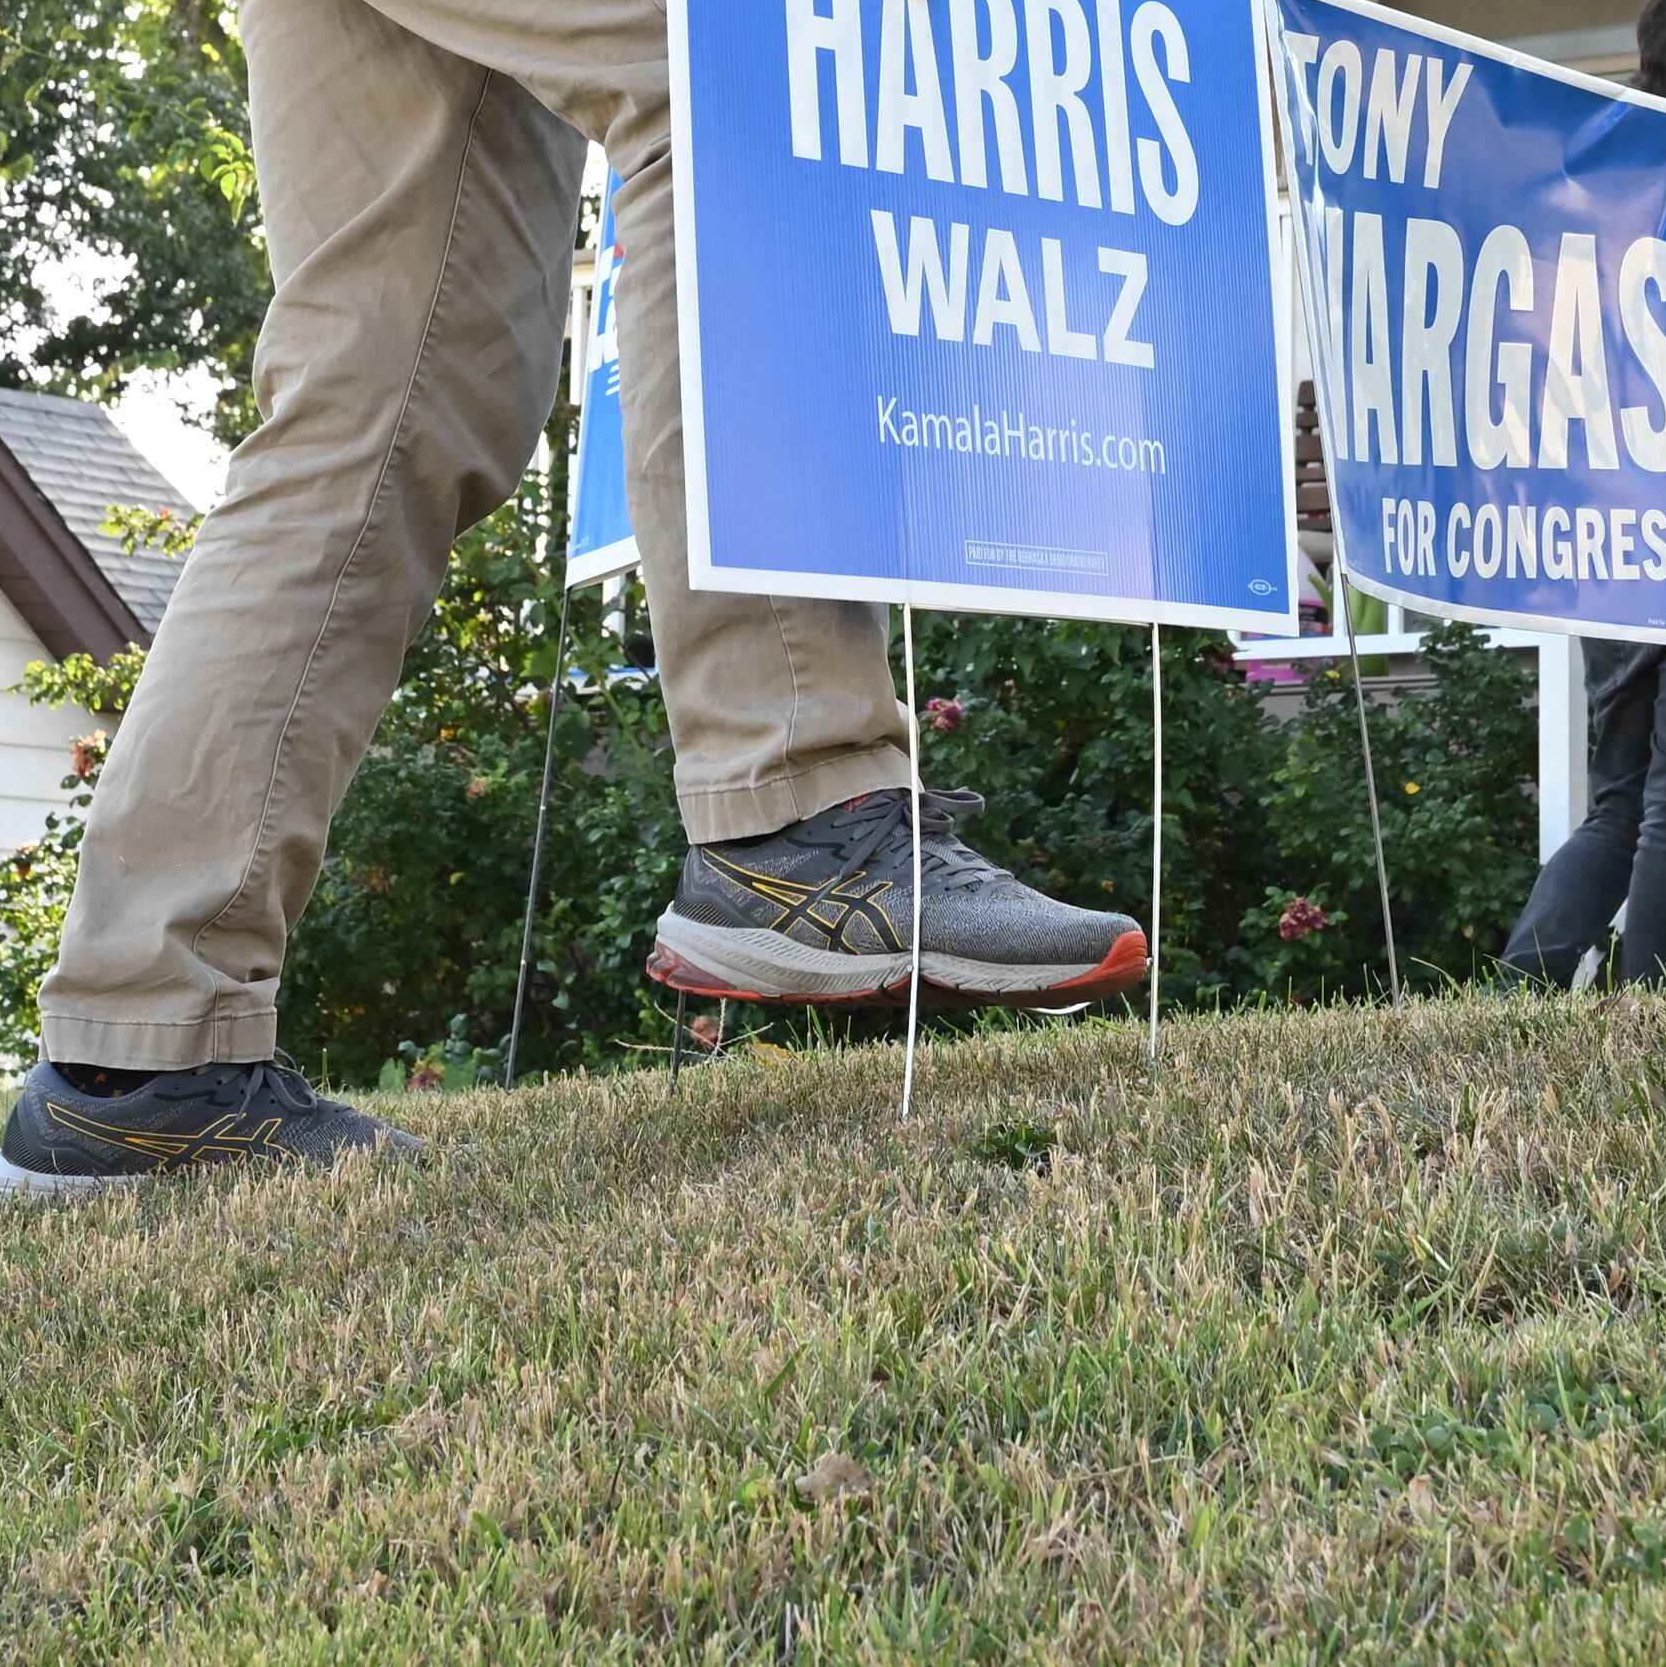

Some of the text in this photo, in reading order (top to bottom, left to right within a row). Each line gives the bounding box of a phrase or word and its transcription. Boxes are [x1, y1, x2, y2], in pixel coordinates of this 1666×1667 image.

[1284, 30, 1474, 189] TONY
[871, 210, 1154, 369] WALZ
[877, 395, 1165, 474] KamalaHarris.com
[1382, 497, 1436, 577] FOR
